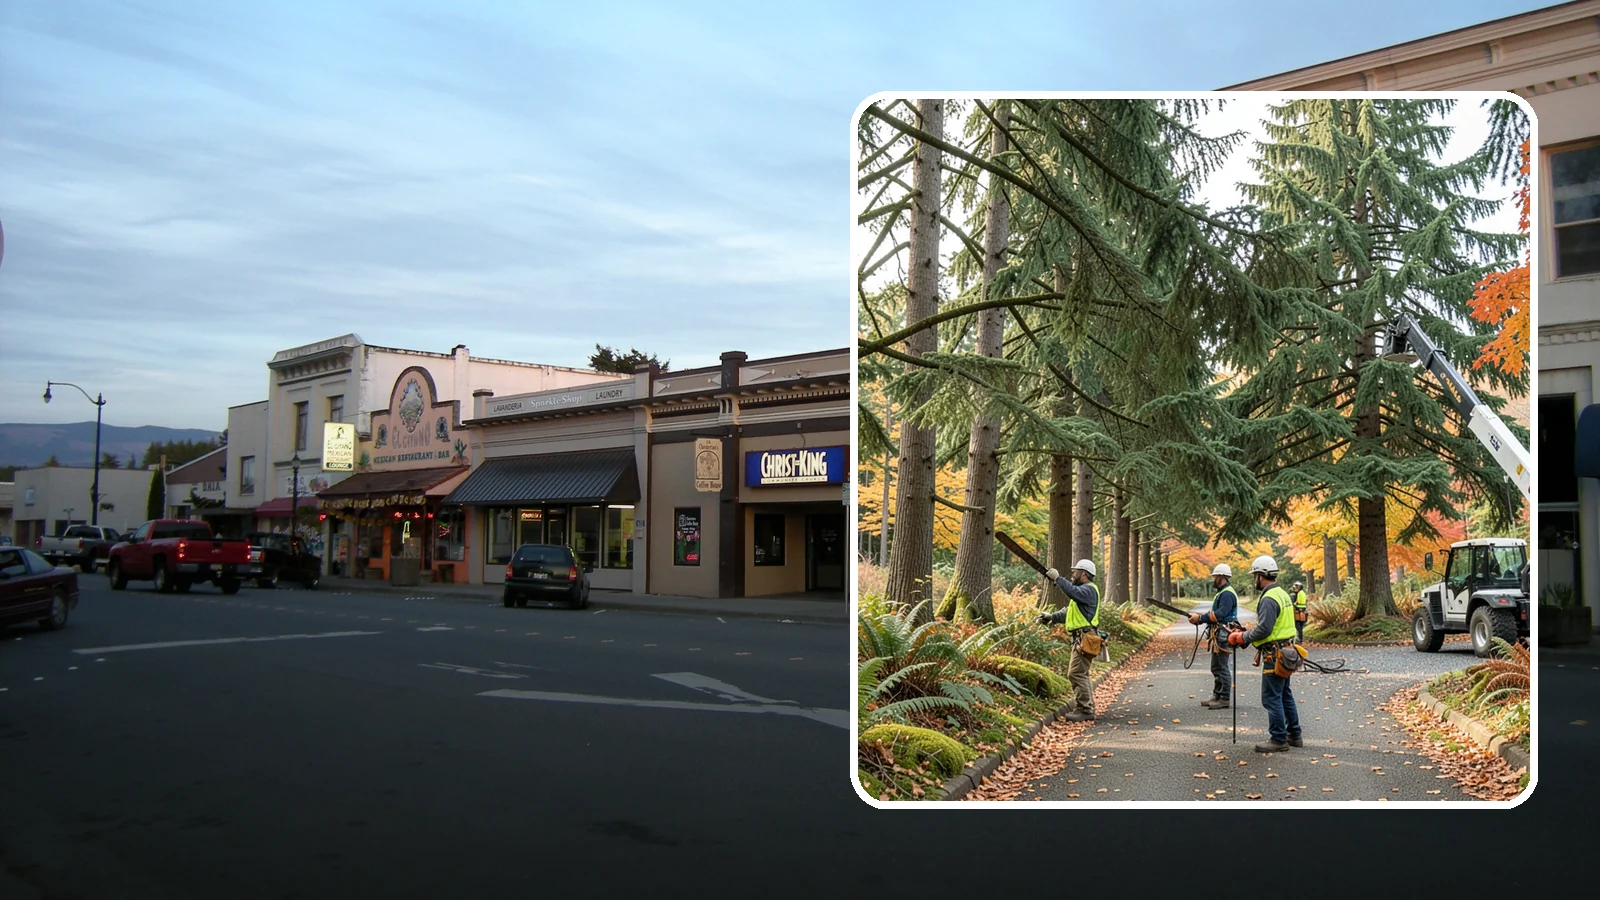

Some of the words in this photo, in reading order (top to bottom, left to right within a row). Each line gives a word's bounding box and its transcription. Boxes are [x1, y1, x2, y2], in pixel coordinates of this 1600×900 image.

[530, 397, 562, 409] Sparkle
[562, 394, 582, 405] Shop
[595, 389, 624, 400] LAUNDRY
[493, 402, 523, 413] LAVANDERIA
[374, 454, 397, 464] MEXICAN
[397, 451, 434, 462] RESTAURANT
[438, 450, 450, 458] BAR
[761, 452, 798, 478] CHRIST
[799, 450, 828, 476] KING
